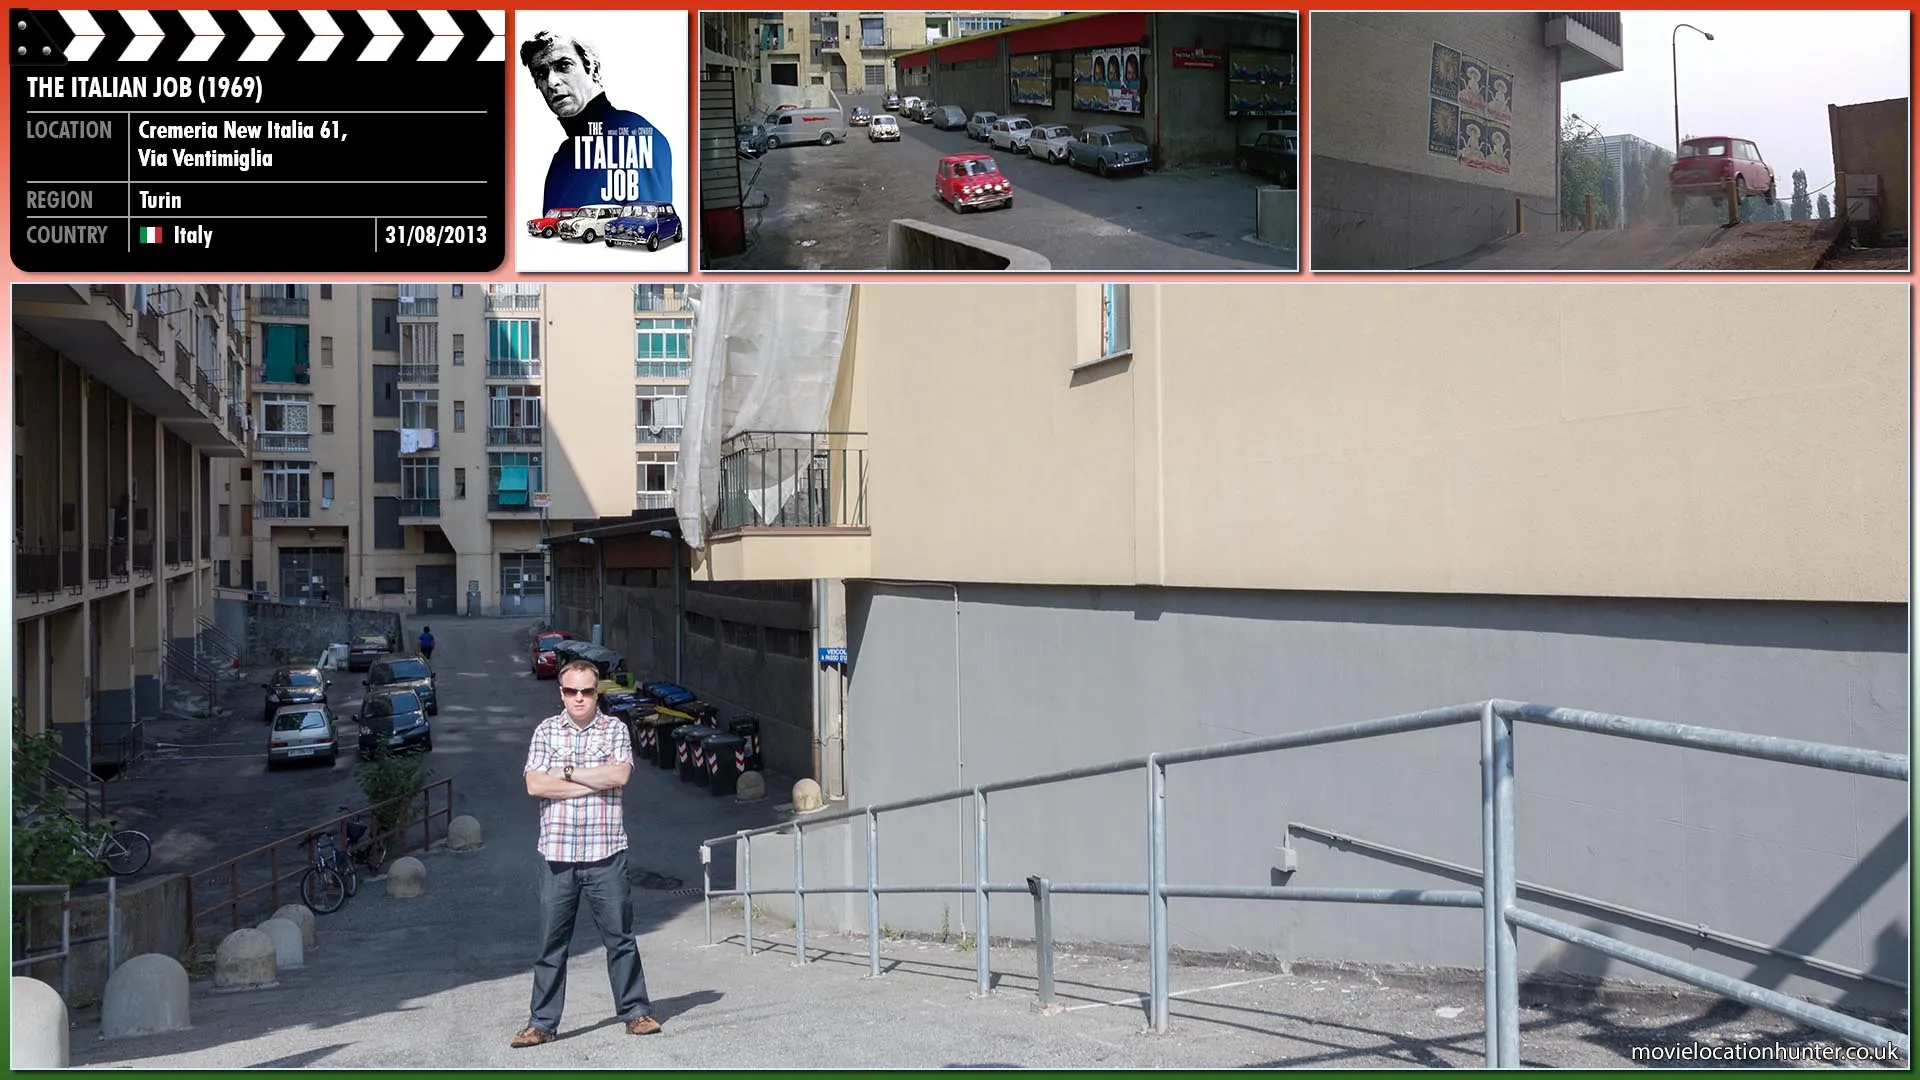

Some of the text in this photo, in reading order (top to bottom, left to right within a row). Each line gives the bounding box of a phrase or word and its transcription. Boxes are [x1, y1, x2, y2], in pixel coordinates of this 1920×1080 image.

[588, 121, 603, 135] THE
[574, 135, 653, 169] ITALIAN
[600, 169, 639, 201] JOB
